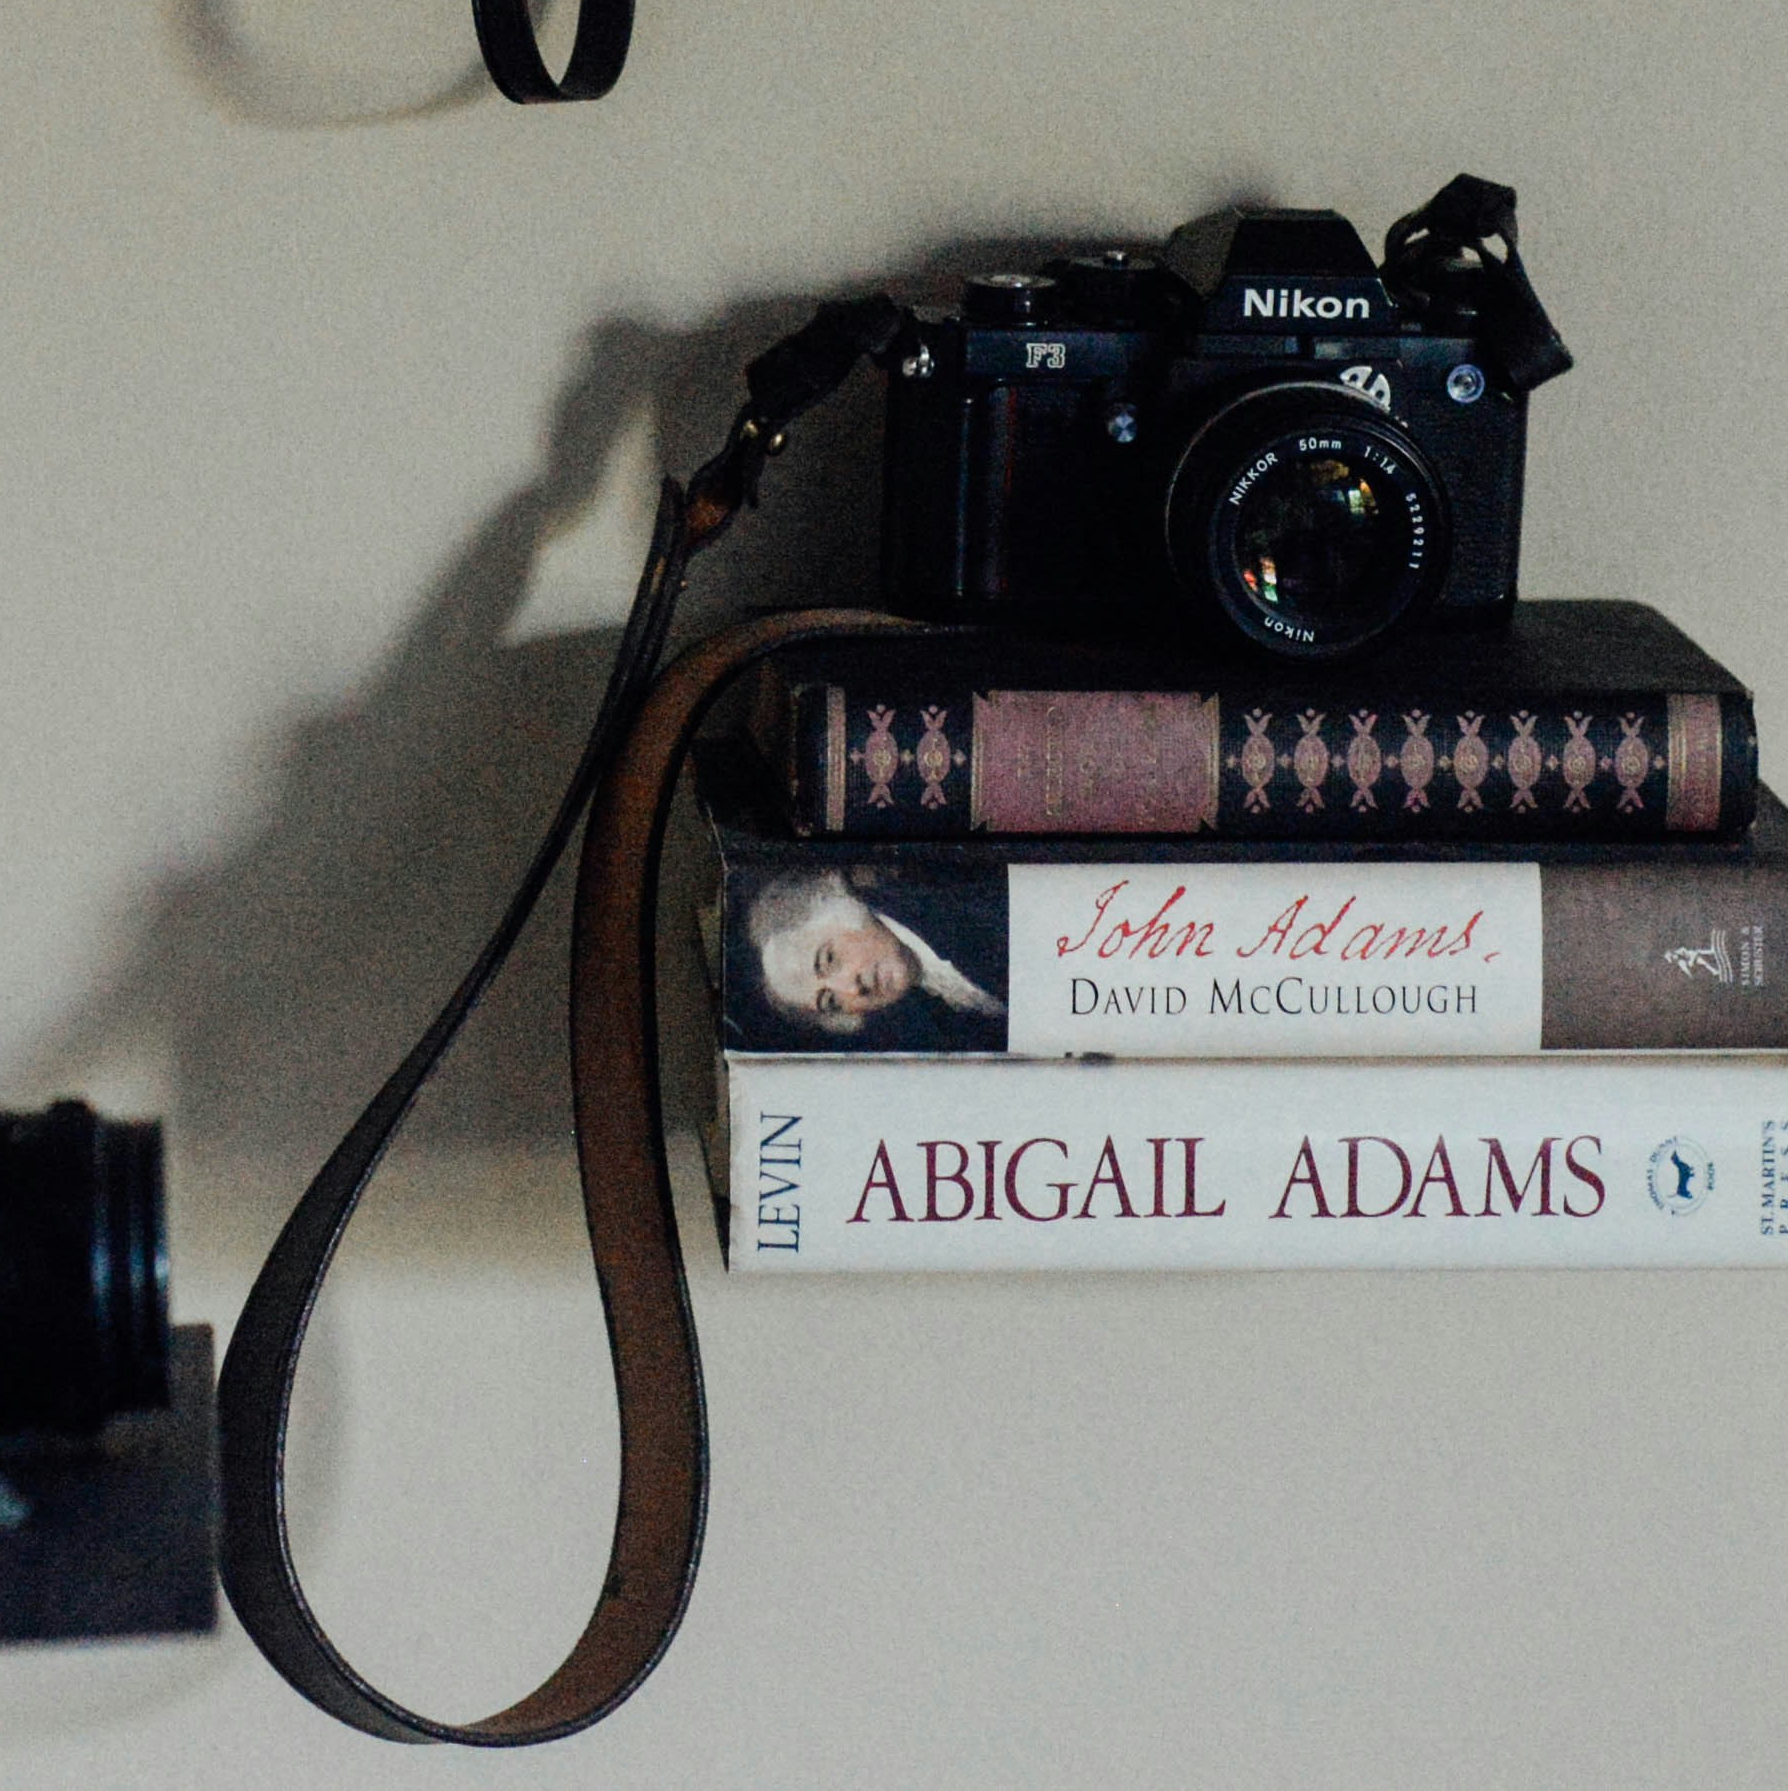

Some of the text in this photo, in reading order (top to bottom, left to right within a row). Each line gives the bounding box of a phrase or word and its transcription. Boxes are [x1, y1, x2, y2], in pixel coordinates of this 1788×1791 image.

[1242, 288, 1371, 319] Nikon
[1026, 342, 1066, 369] F3
[1228, 451, 1279, 506] NIKKOR
[1298, 436, 1343, 452] 50mm
[1263, 615, 1315, 643] Nikon
[1056, 879, 1214, 959] John
[1740, 941, 1751, 987] SIMON
[1069, 976, 1188, 1016] DAVID
[756, 1111, 804, 1253] LEVIN
[846, 1133, 1607, 1224] ABIGAIL ADAMS
[1760, 1119, 1776, 1208] MARTIN'S
